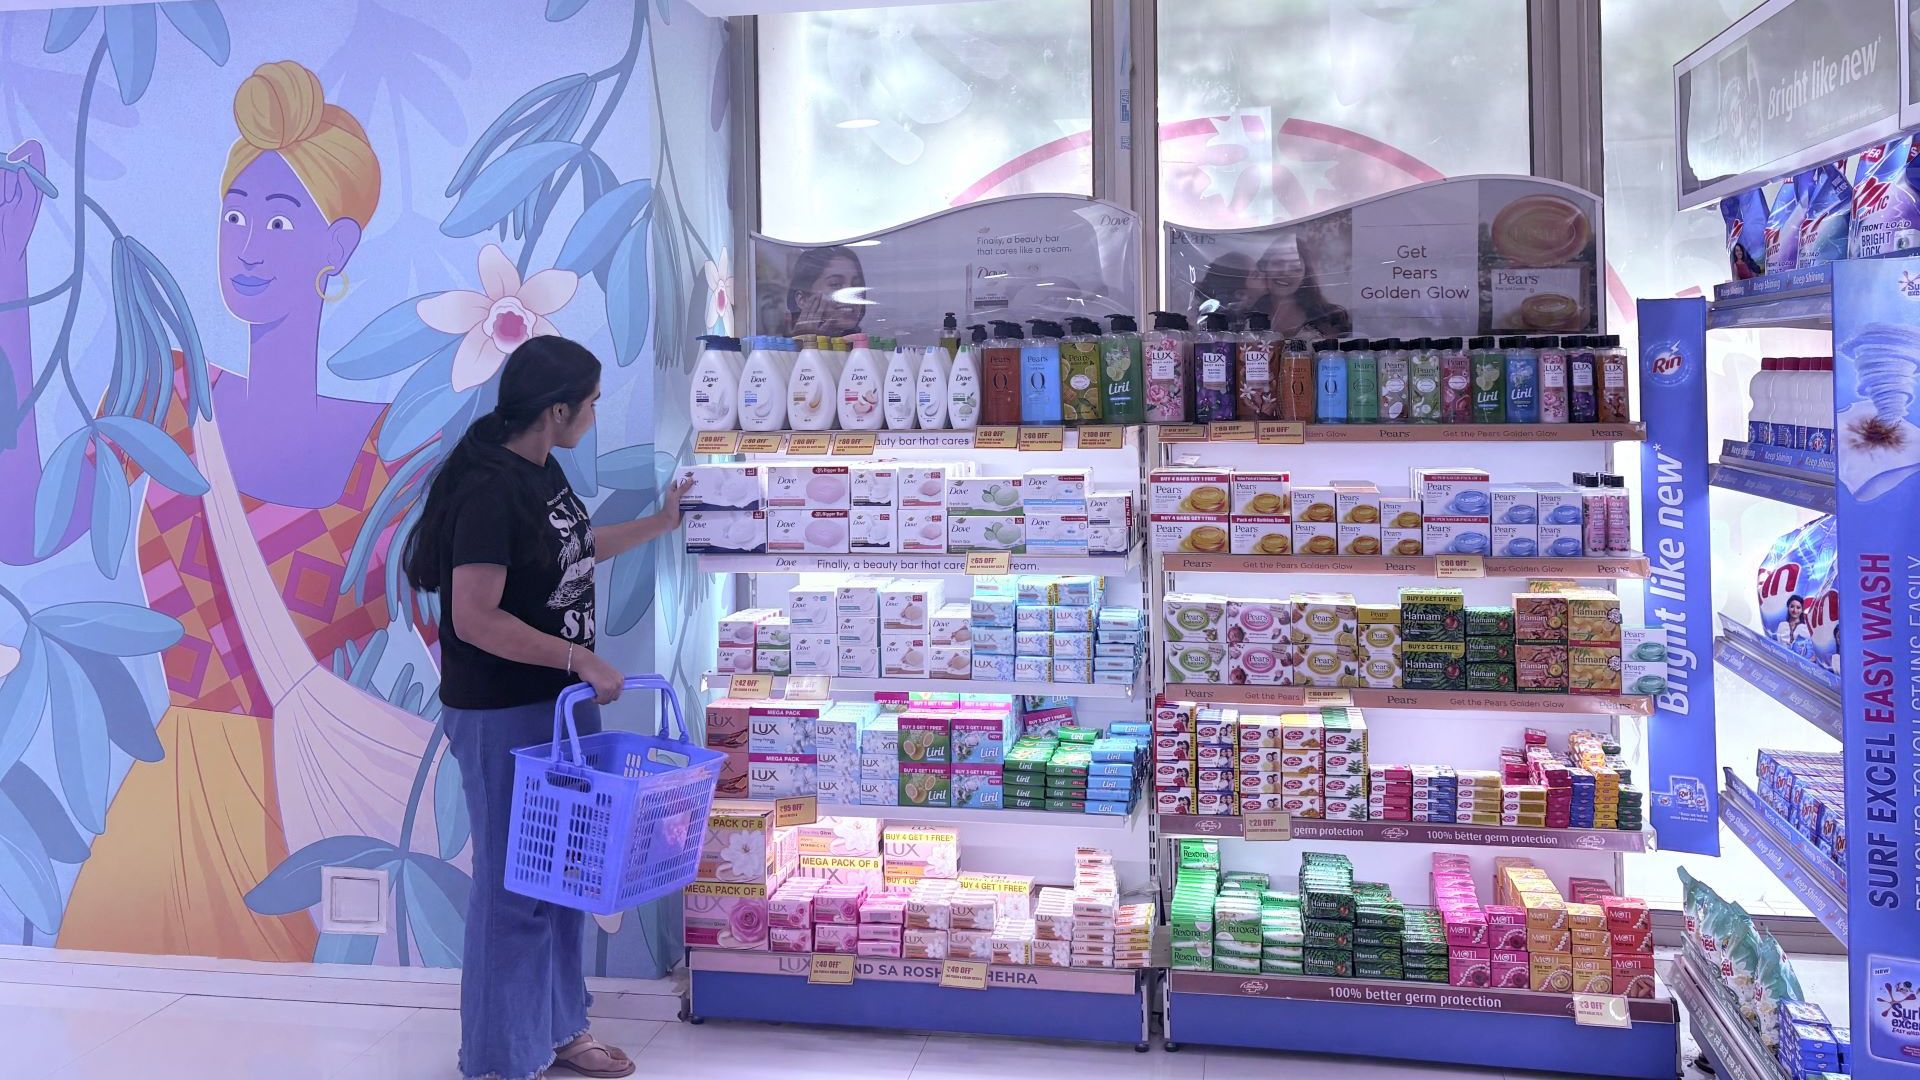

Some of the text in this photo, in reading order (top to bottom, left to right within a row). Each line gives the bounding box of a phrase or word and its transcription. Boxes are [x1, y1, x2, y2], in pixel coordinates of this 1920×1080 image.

[1767, 69, 1809, 123] Bright
[1811, 56, 1837, 100] like
[1099, 214, 1130, 228] Dove
[977, 237, 1004, 245] Finally,
[1015, 235, 1042, 244] beauty
[1170, 231, 1216, 245] Pears
[1862, 232, 1891, 247] BRIGHT
[996, 247, 1017, 255] cares
[1020, 246, 1033, 254] like
[1396, 245, 1427, 259] Get
[1392, 266, 1437, 281] Pears
[1497, 272, 1539, 286] Pears
[1361, 286, 1470, 300] Golden Glow
[1152, 351, 1173, 360] LUX
[1203, 354, 1225, 363] LUX
[1652, 354, 1683, 375] Rin
[1108, 380, 1130, 395] Liril
[1477, 391, 1498, 403] Liril
[1379, 430, 1410, 438] Pears
[1591, 429, 1623, 437] Pears
[899, 436, 916, 446] bar
[918, 436, 940, 446] that
[941, 437, 969, 446] cares
[1765, 452, 1792, 464] Keep Shining
[777, 477, 797, 485] Dove
[949, 487, 968, 495] Dove
[1156, 485, 1182, 494] Pears
[776, 520, 796, 528] Dove
[1156, 524, 1183, 533] Pears
[1235, 525, 1258, 533] Pears
[776, 558, 797, 567] Dove
[818, 559, 851, 570] Finally,
[863, 559, 898, 571] beauty
[901, 560, 918, 569] bar
[921, 560, 941, 570] that
[944, 562, 966, 570] care
[1009, 562, 1040, 571] ream.
[1183, 559, 1212, 568] Pears
[1243, 561, 1258, 569] Get
[1260, 561, 1274, 569] the
[1300, 562, 1328, 570] Golden
[1330, 562, 1353, 570] Glow
[1386, 563, 1416, 571] Pears
[1509, 565, 1539, 573] Golden
[1541, 565, 1563, 573] Glow
[1650, 538, 1686, 601] like
[1404, 611, 1440, 620] Hamam
[560, 609, 595, 640] SK
[1405, 660, 1443, 669] Hamam
[1184, 689, 1214, 697] Pears
[1387, 695, 1417, 703] Pears
[1450, 699, 1465, 707] Get
[1468, 699, 1482, 707] the
[1509, 700, 1540, 708] Golden
[1542, 700, 1564, 708] Glow
[752, 723, 779, 735] LUX
[1860, 553, 1899, 909] SURF EXCEL EASY WASH
[927, 747, 944, 757] Liril
[928, 790, 947, 801] Liril
[713, 819, 763, 828] PACK OF 8
[1294, 826, 1364, 837] germ protection
[1427, 830, 1558, 845] 100% better germ protection
[885, 842, 920, 857] LUX
[1183, 850, 1209, 859] Rexona
[802, 857, 879, 869] MEGA PACK OF 8
[685, 883, 765, 896] MEGA PACK OF 8
[1793, 877, 1826, 911] Keep Shining
[1311, 900, 1337, 909] Hamam
[1609, 910, 1631, 919] MOTI
[1613, 934, 1635, 943] MOTI
[1174, 952, 1201, 963] Rexona
[1493, 953, 1517, 962] MOTI
[778, 957, 812, 972] LUX
[855, 963, 874, 974] ND
[878, 965, 898, 976] SA
[903, 966, 943, 978] ROSH
[988, 970, 1038, 984] HEHRA
[1329, 987, 1501, 1009] 100% better germ protection
[1892, 1019, 1920, 1030] exce
